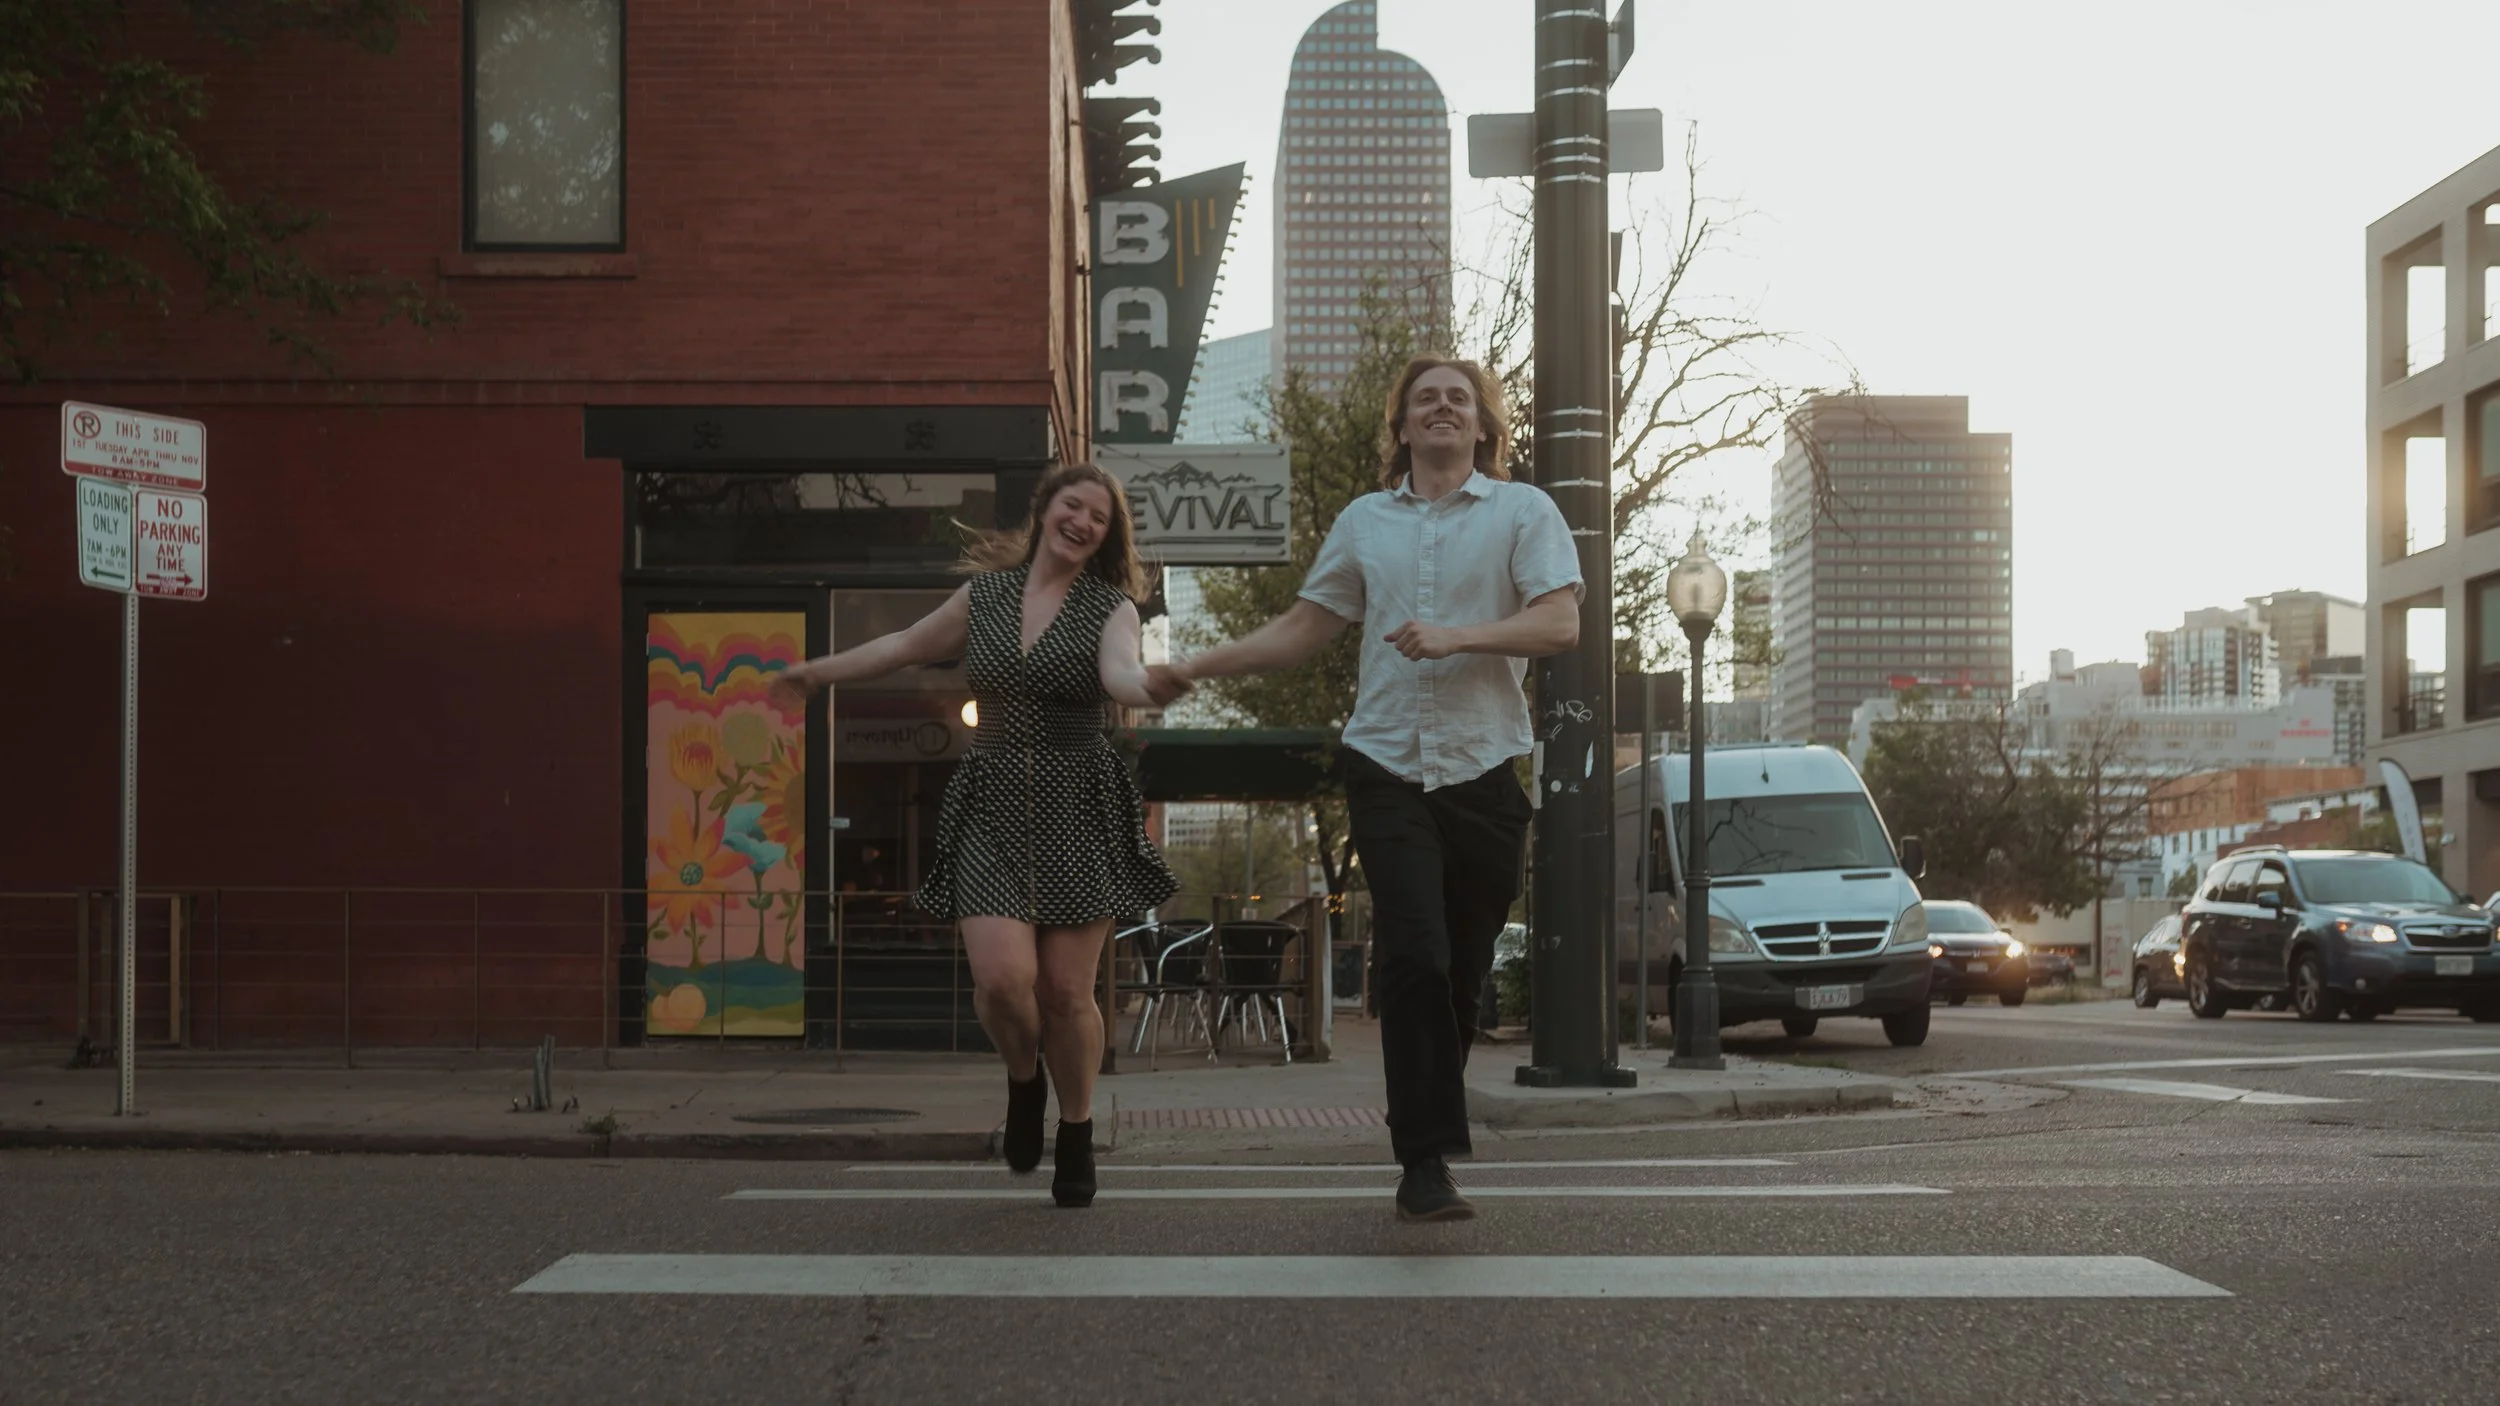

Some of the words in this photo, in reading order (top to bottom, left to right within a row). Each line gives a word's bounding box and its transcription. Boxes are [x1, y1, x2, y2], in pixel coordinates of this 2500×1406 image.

[1100, 202, 1170, 433] BAR
[115, 421, 142, 439] THIS
[154, 427, 179, 445] SIDE
[95, 440, 128, 454] TUESDAY
[132, 447, 150, 458] APR
[156, 451, 177, 463] THRU
[182, 455, 199, 465] NOV
[92, 466, 113, 477] TOW
[118, 469, 146, 482] AWAY
[152, 474, 179, 487] ZONE
[83, 487, 128, 514] LOADING
[158, 499, 183, 520] NO
[1127, 484, 1285, 531] EVIVAL
[93, 513, 119, 536] ONLY
[140, 520, 200, 545] PARKING
[158, 543, 183, 558] ANY
[157, 556, 185, 572] TIME
